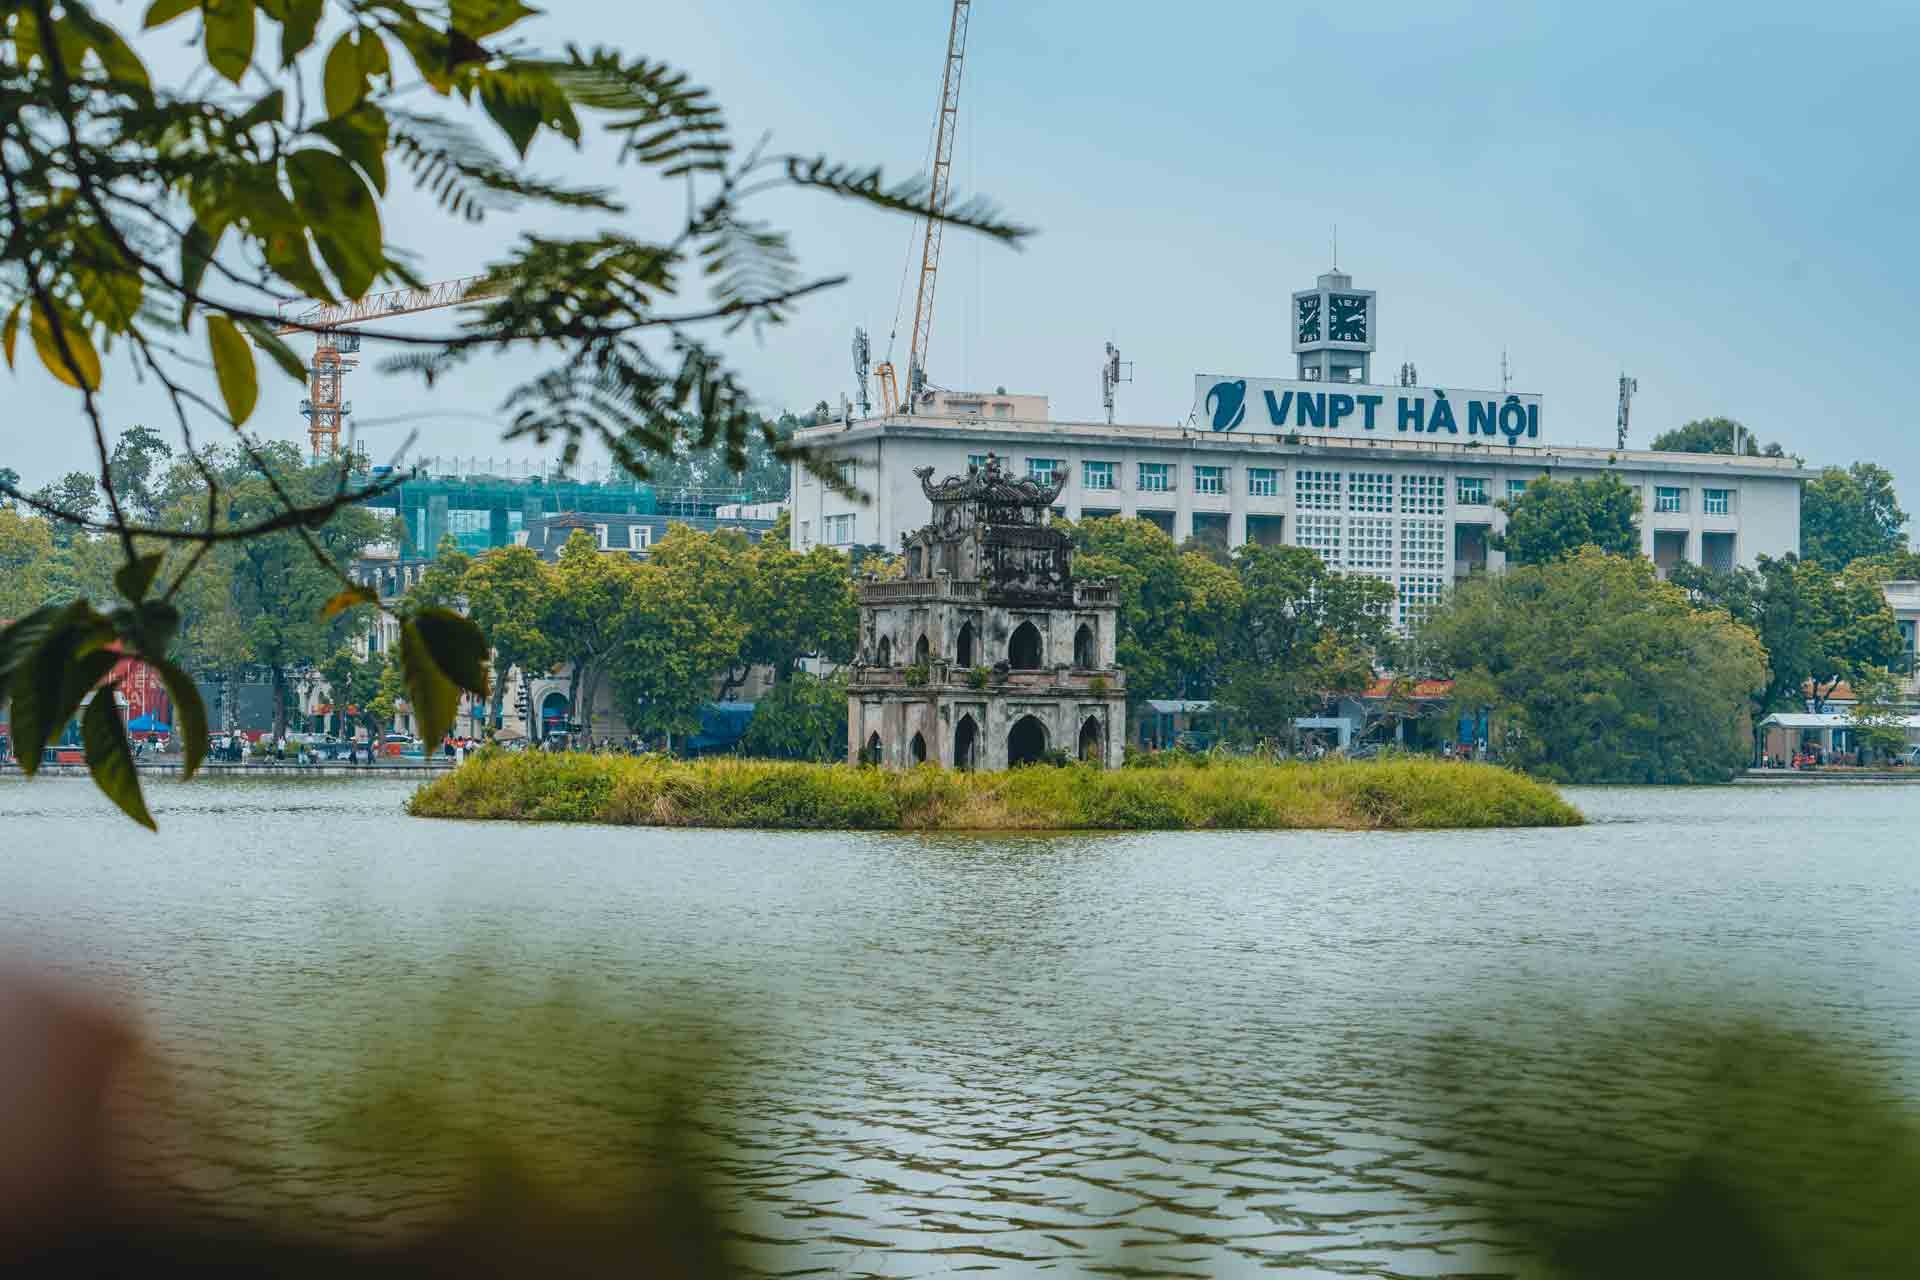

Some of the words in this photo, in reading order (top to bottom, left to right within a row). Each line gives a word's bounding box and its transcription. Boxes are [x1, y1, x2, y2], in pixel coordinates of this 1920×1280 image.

[1343, 299, 1353, 307] 12
[1264, 389, 1383, 430] VNPT
[1397, 389, 1458, 434] HÀ
[1468, 395, 1539, 446] NỘI
